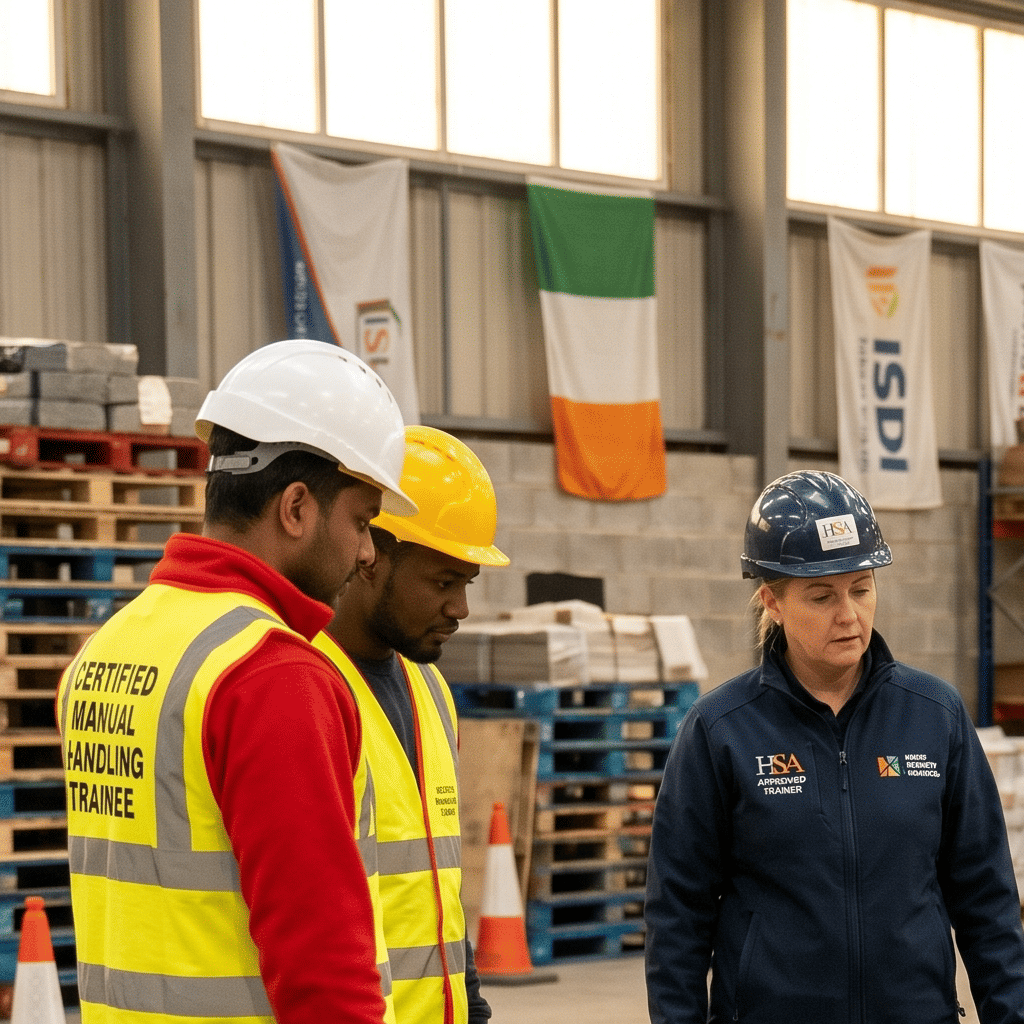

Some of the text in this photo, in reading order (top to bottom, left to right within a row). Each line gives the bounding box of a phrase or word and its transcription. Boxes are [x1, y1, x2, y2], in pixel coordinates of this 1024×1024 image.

[873, 338, 908, 472] ISDI
[821, 521, 853, 538] HSA
[75, 661, 159, 696] CERTIFIED
[71, 700, 136, 736] MANUAL
[755, 753, 805, 776] HSA
[69, 781, 135, 819] TRAINEE
[764, 785, 802, 795] TRAINER
